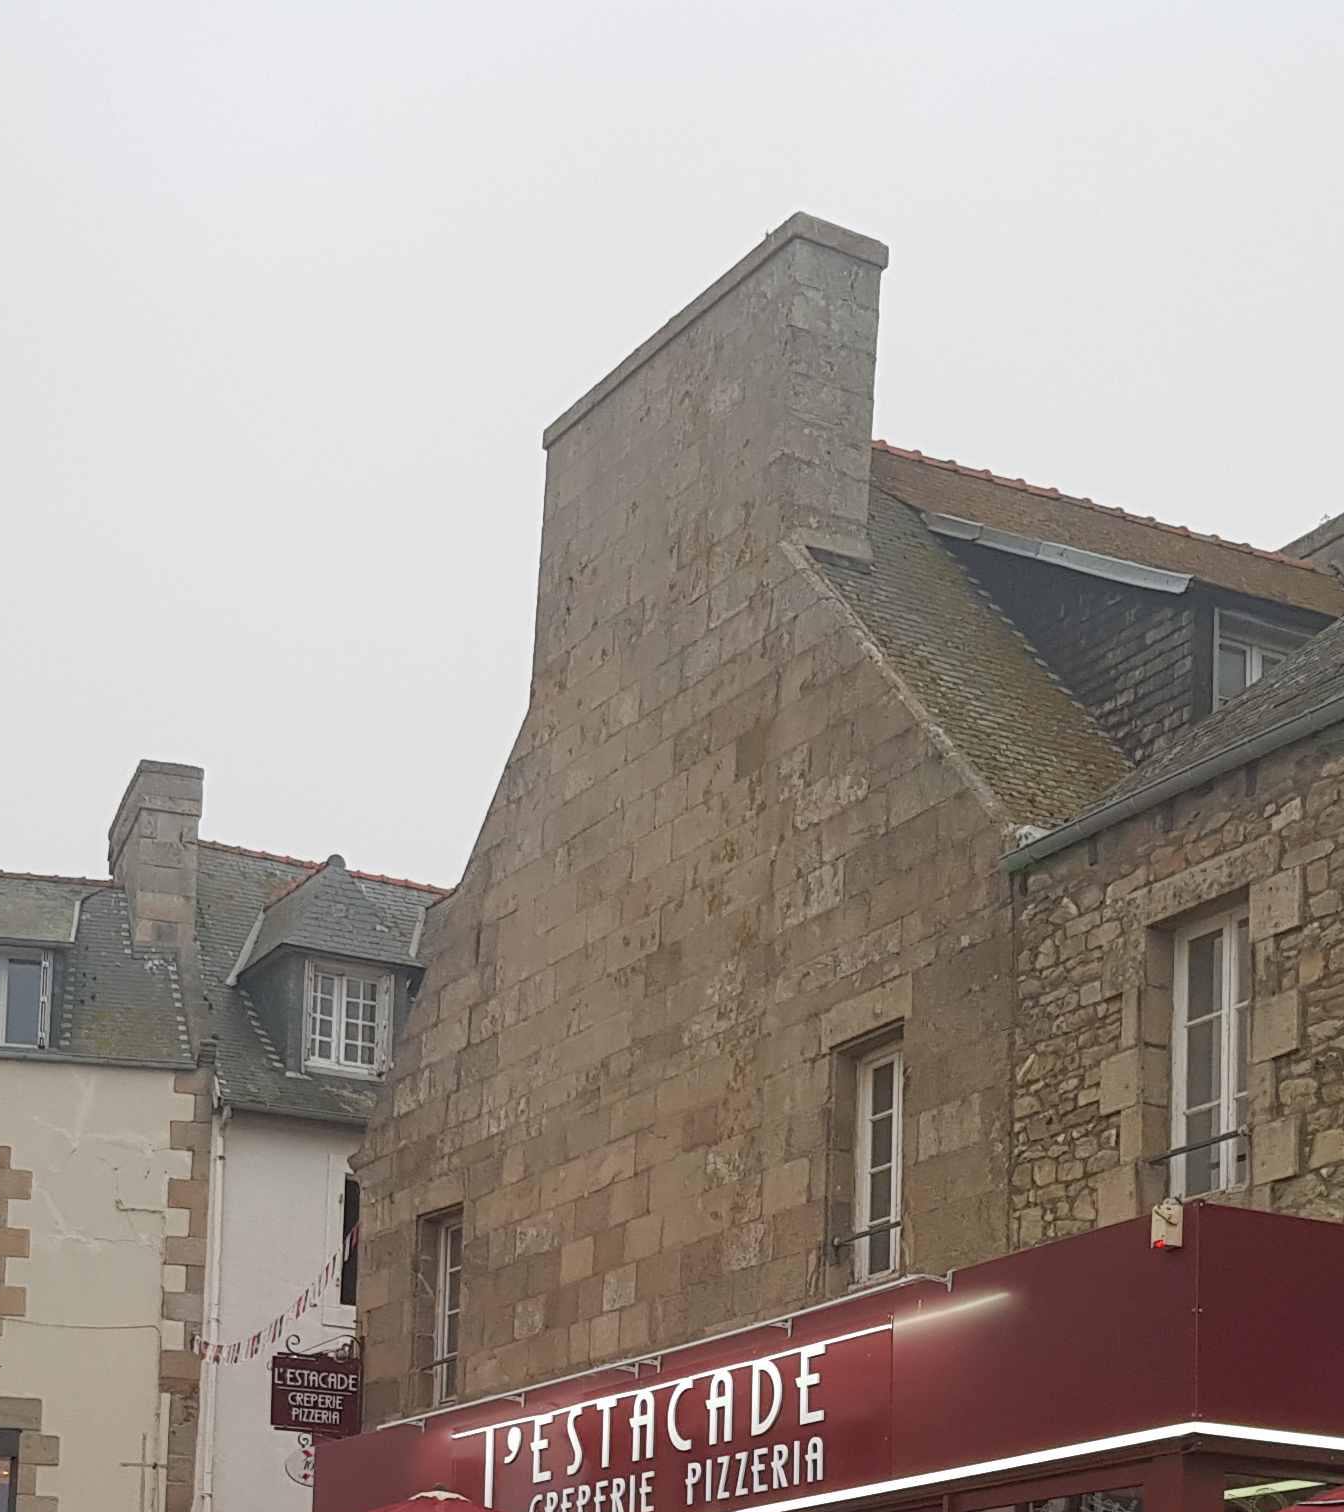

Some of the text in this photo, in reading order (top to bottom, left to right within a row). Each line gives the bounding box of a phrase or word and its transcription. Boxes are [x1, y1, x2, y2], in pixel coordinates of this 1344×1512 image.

[274, 1366, 358, 1392] L'ESTACADE
[287, 1391, 344, 1410] CREPERIE
[291, 1407, 340, 1425] PIZZERIA
[685, 1436, 825, 1506] PIZZERIA
